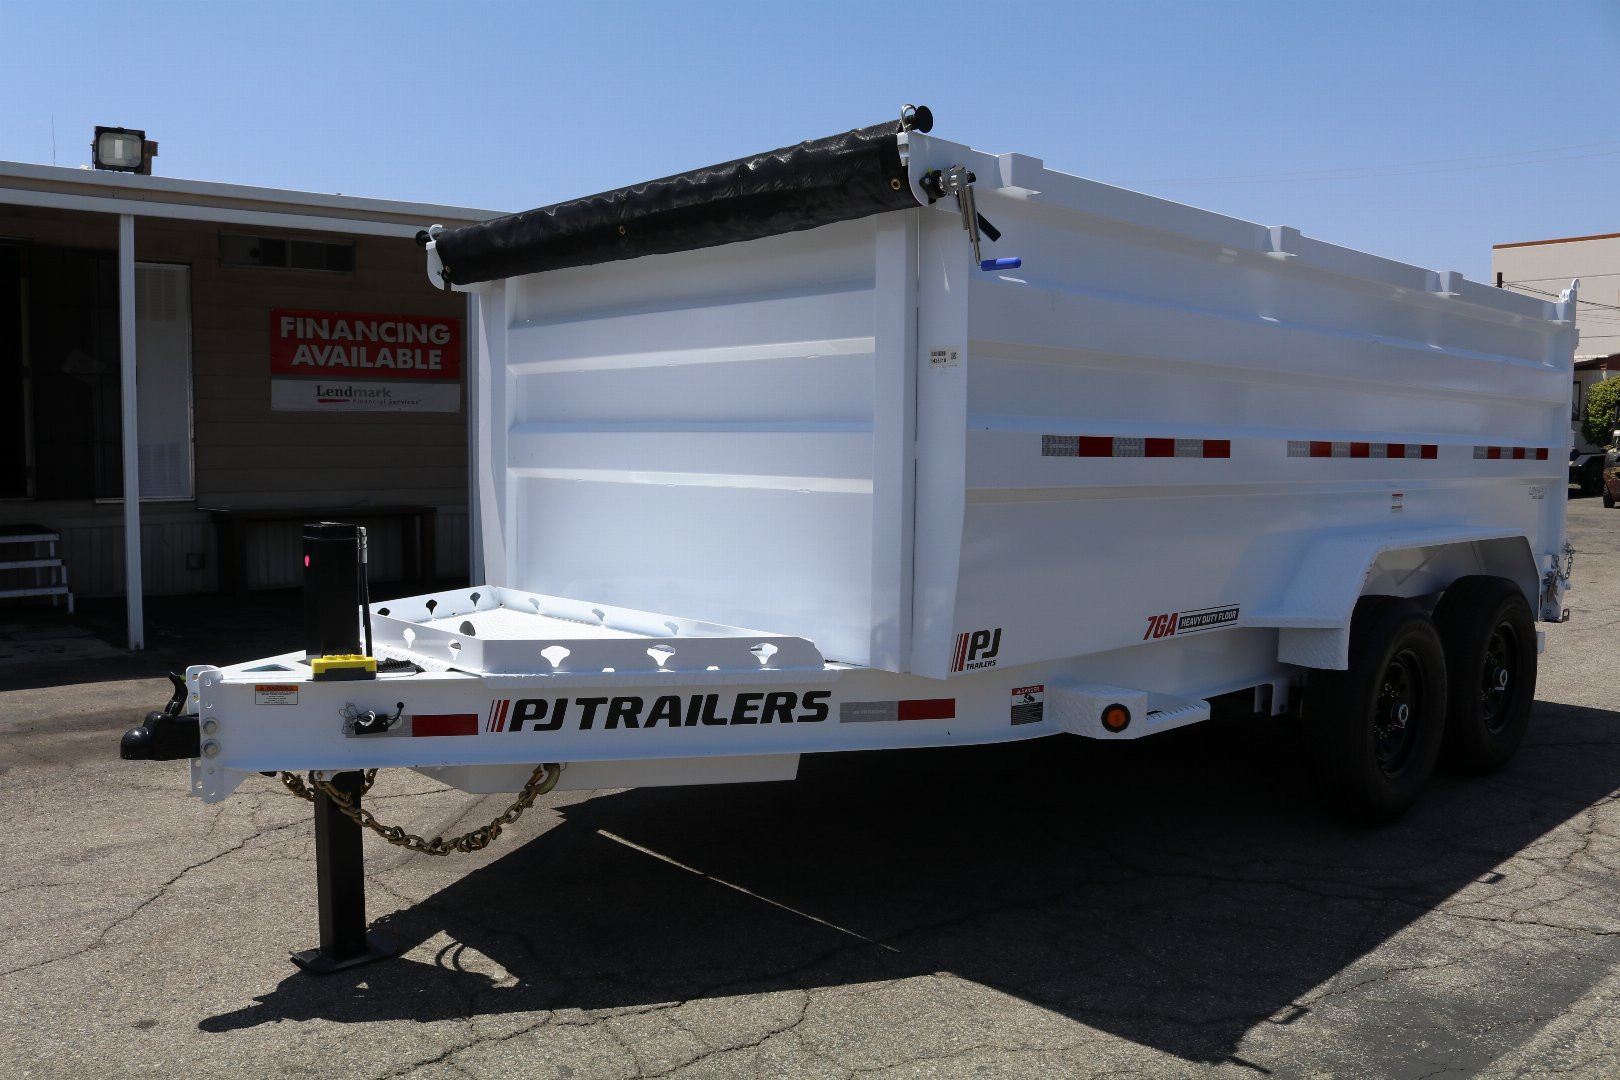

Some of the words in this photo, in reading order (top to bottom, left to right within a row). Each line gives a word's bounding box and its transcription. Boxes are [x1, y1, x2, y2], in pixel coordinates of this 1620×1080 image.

[280, 316, 450, 345] FINANCING
[291, 344, 442, 370] AVAILABLE
[316, 385, 391, 398] Lendmark
[1142, 612, 1179, 640] 7GA
[1181, 616, 1202, 627] HEAVY
[1202, 614, 1218, 624] DUTY
[1218, 610, 1237, 621] FLOOR
[968, 628, 1002, 661] PJ
[966, 660, 997, 670] TRAILERS
[508, 698, 569, 733] PJ
[575, 690, 832, 730] TRAILERS
